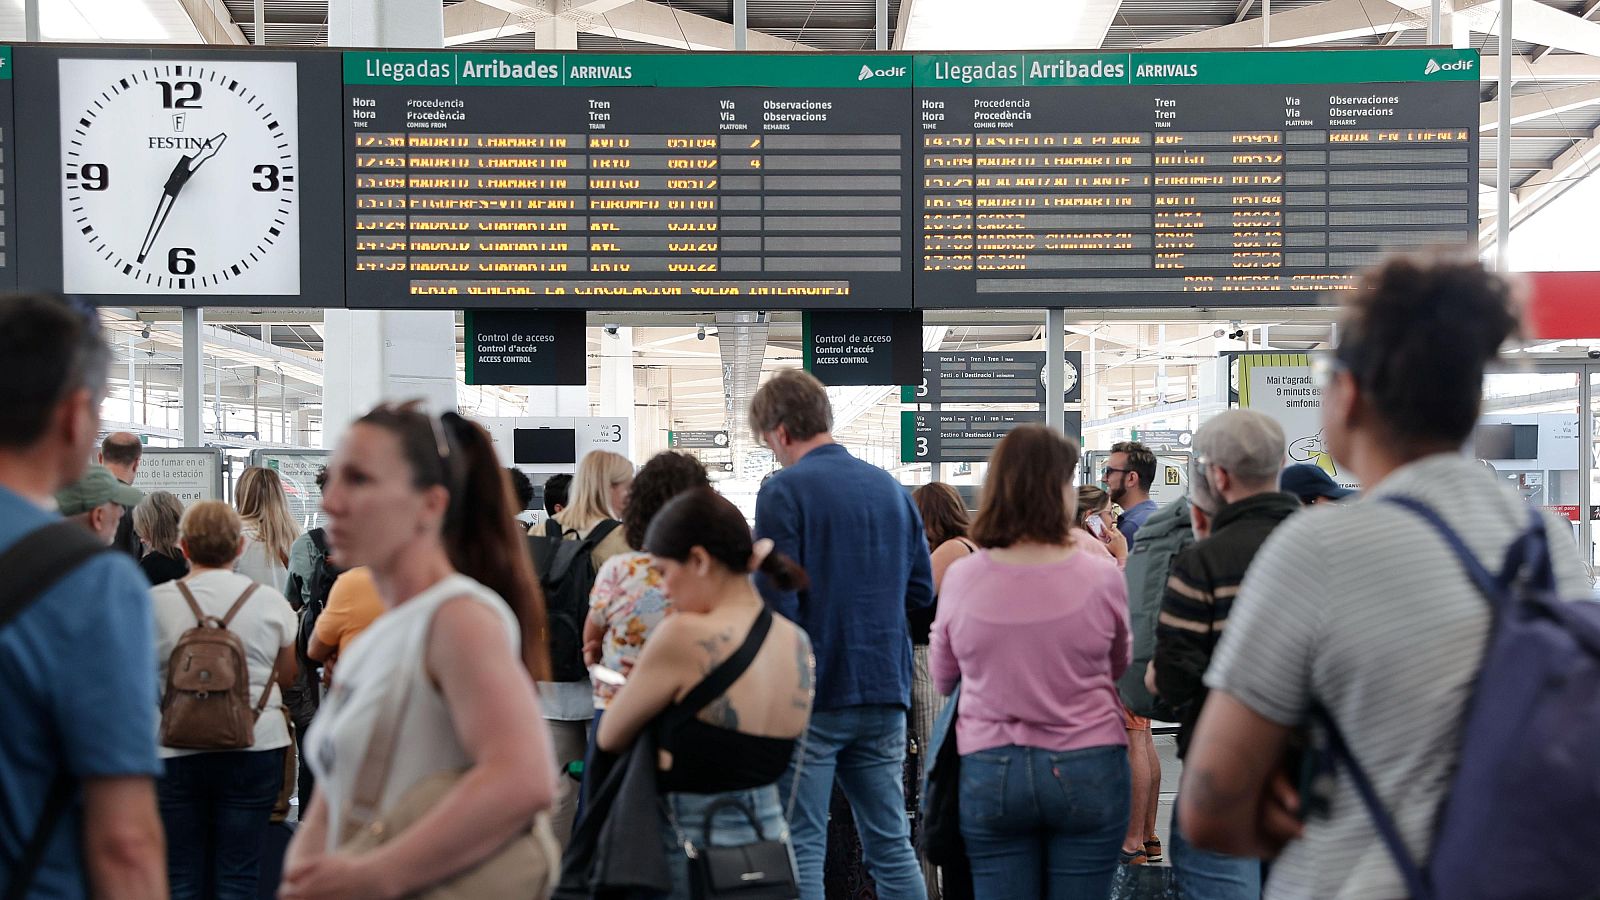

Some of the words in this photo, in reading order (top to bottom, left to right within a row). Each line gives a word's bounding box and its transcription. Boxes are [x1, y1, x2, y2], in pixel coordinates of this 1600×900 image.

[463, 60, 557, 78] Arribades
[1030, 60, 1124, 78] Arribades
[1441, 60, 1474, 70] adif
[367, 60, 449, 81] Llegadas
[571, 67, 631, 78] ARRIVALS
[874, 66, 906, 77] adif
[936, 62, 1017, 83] Llegadas
[1136, 65, 1197, 77] ARRIVALS
[156, 82, 203, 109] 12
[1330, 95, 1398, 104] Observaciones
[353, 98, 375, 106] Hora
[408, 99, 463, 107] Procedencia
[589, 100, 610, 108] Tren
[764, 100, 832, 109] Observaciones
[922, 100, 944, 108] Hora
[975, 99, 1030, 107] Procedencia
[1155, 98, 1175, 107] Tren
[353, 110, 375, 118] Hora
[408, 110, 465, 120] Procedència
[589, 112, 610, 120] Tren
[720, 112, 735, 120] Via
[923, 112, 944, 120] Hora
[975, 110, 1031, 119] Procedència
[1155, 110, 1175, 118] Tren
[1286, 109, 1300, 117] Via
[1330, 107, 1393, 116] Observacions
[764, 112, 826, 121] Observacions
[148, 137, 212, 150] FESTINA
[81, 163, 109, 191] 9
[252, 164, 279, 192] 3
[168, 248, 196, 276] 6
[478, 334, 508, 342] Control
[512, 334, 522, 342] de
[816, 334, 846, 343] Control
[849, 334, 860, 342] de
[863, 335, 891, 343] acceso
[916, 378, 928, 397] 3
[1284, 388, 1310, 396] minuts
[612, 425, 622, 443] 3
[916, 437, 928, 456] 3
[173, 470, 203, 478] estación
